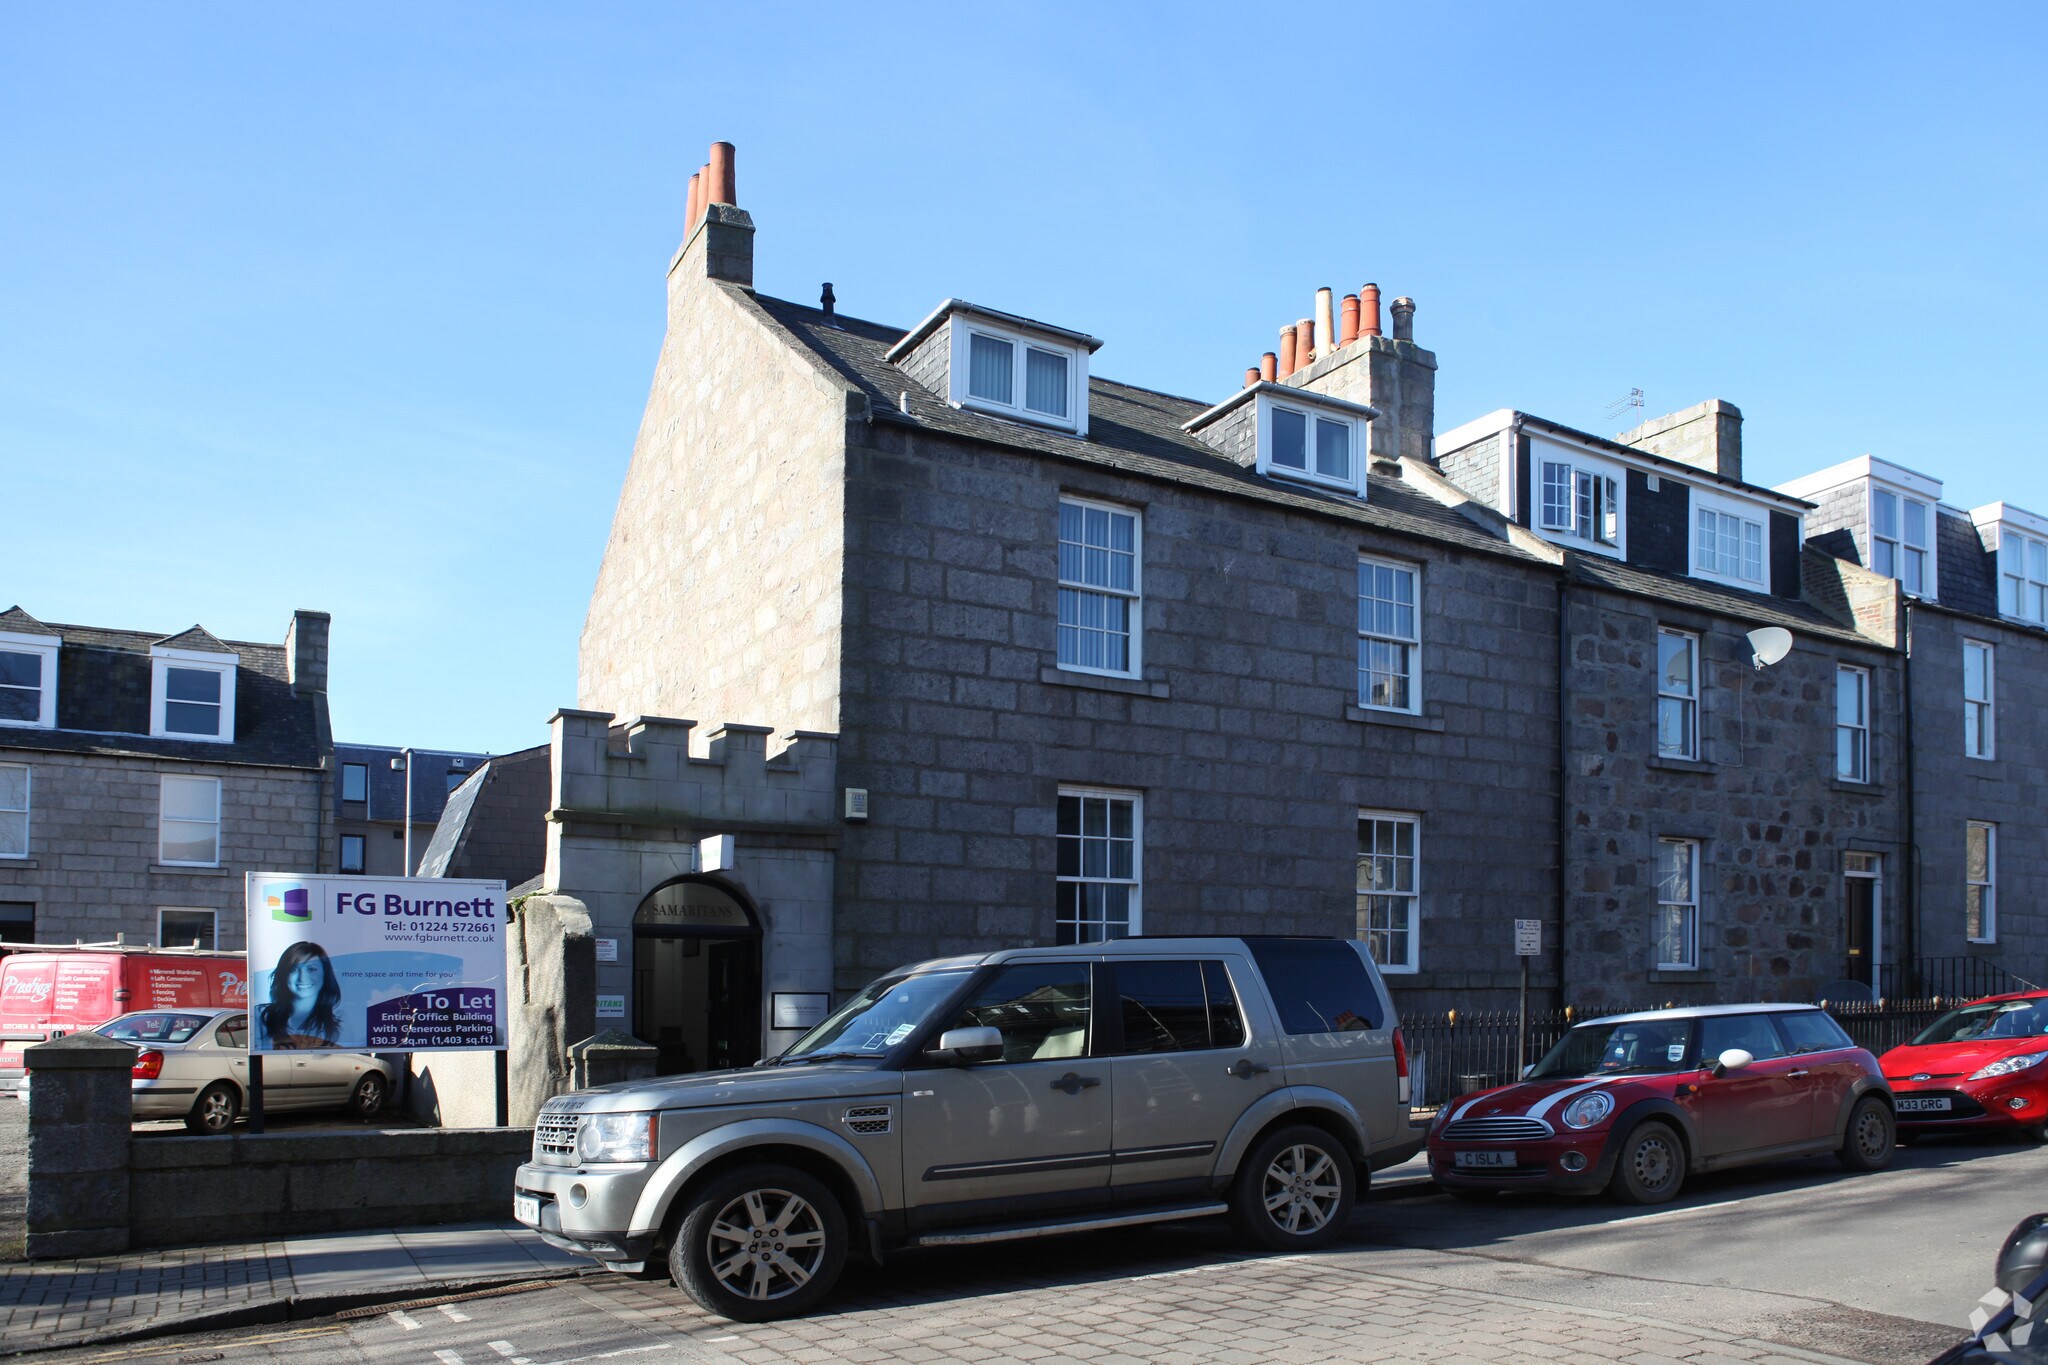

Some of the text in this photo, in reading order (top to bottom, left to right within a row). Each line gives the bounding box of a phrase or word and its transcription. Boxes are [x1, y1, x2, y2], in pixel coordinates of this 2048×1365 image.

[337, 892, 495, 918] FG Burnett
[653, 904, 732, 917] SAMARITANS
[385, 921, 495, 933] Tel: 01224 572661
[385, 933, 494, 943] www.fgburnett.co.uk
[365, 971, 386, 979] space
[439, 971, 454, 979] you
[4, 976, 52, 1002] Prestige
[422, 993, 492, 1009] To Let
[381, 1012, 493, 1022] Entire Office Building
[373, 1024, 493, 1034] with Generous Parking
[371, 1036, 397, 1045] 130.3
[431, 1035, 462, 1046] (1,403
[465, 1035, 493, 1046] sq.ft)
[1920, 1099, 1943, 1109] GRG
